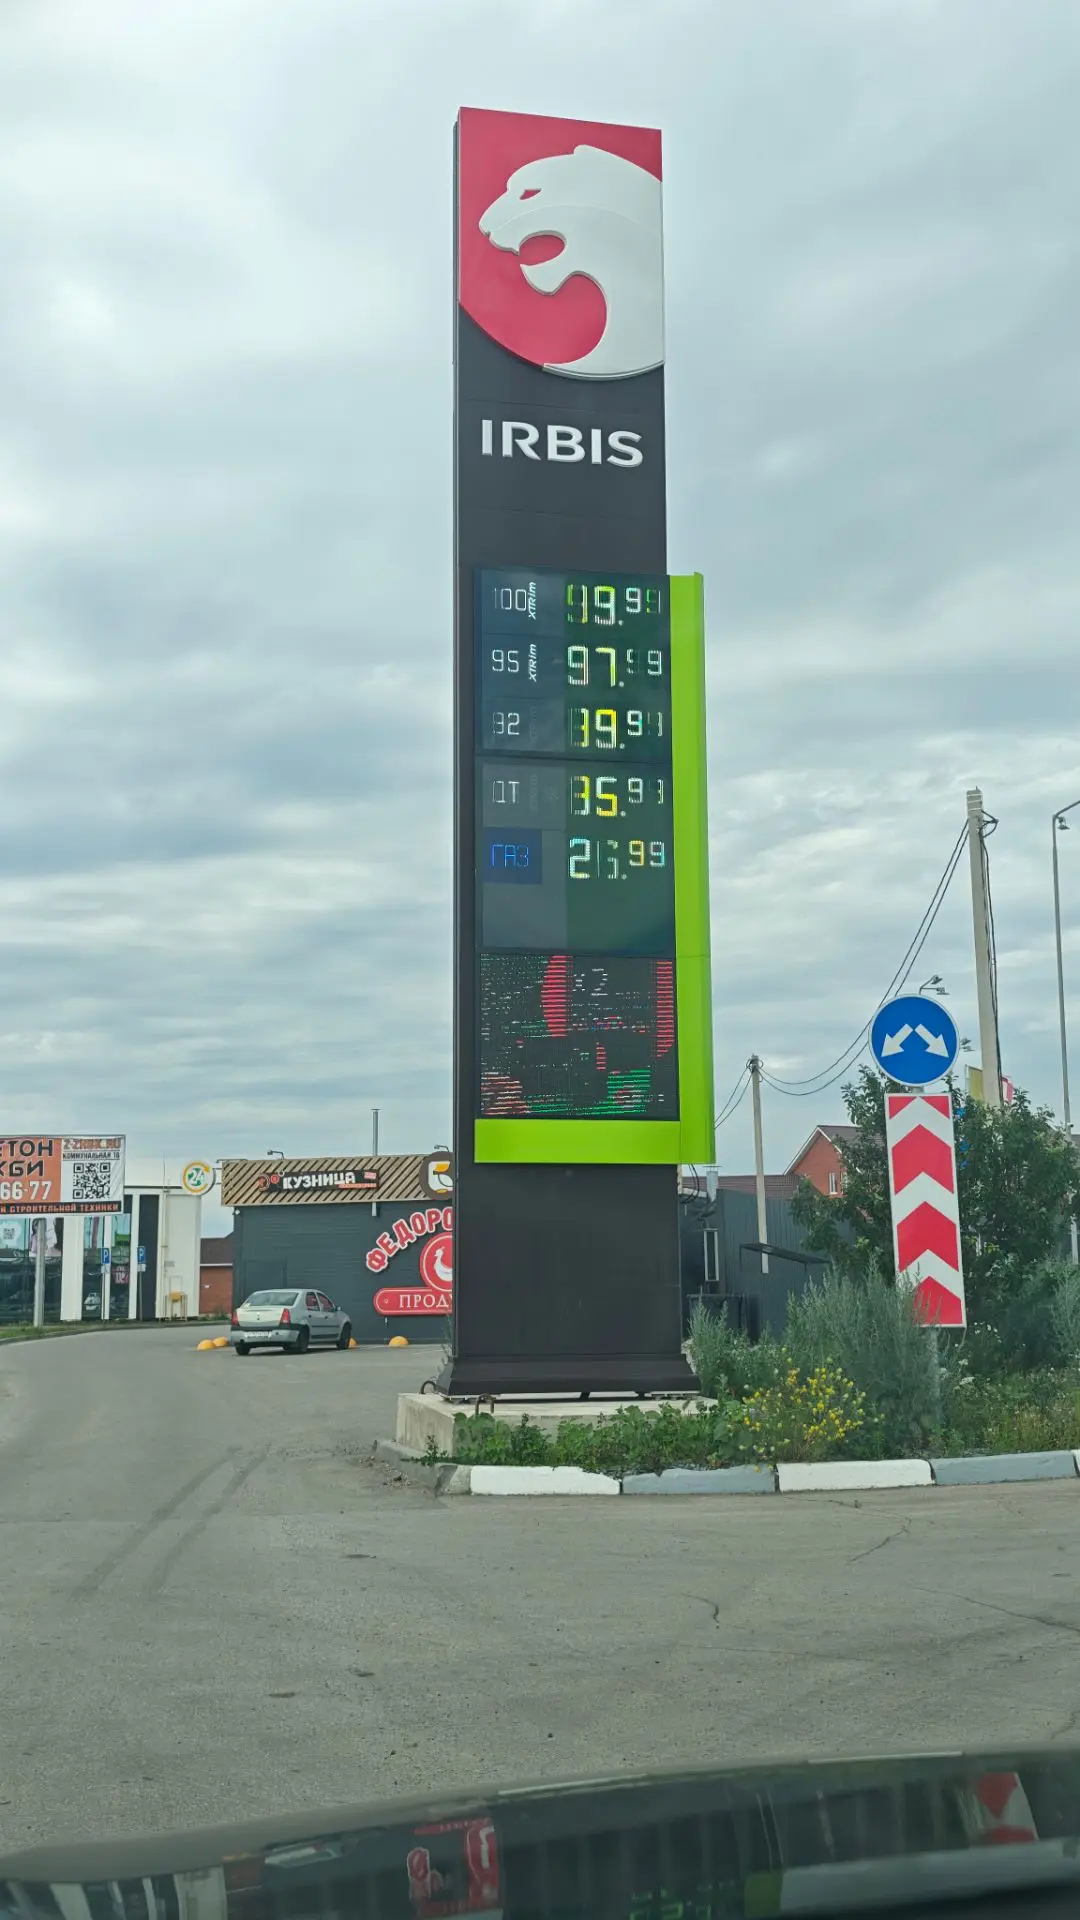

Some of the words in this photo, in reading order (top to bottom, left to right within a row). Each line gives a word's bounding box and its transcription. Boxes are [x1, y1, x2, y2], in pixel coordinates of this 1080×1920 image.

[481, 419, 643, 467] IRBIS
[493, 587, 527, 611] 100
[492, 649, 520, 673] 95
[0, 1140, 53, 1157] ТОН
[282, 1171, 356, 1190] КУЗНИЦА
[0, 1181, 52, 1200] 66-77
[10, 1203, 77, 1213] СТРОИТЕЛЬНОЙ
[80, 1203, 119, 1213] ТЕХНИКИ
[399, 1293, 452, 1309] ПРОД
